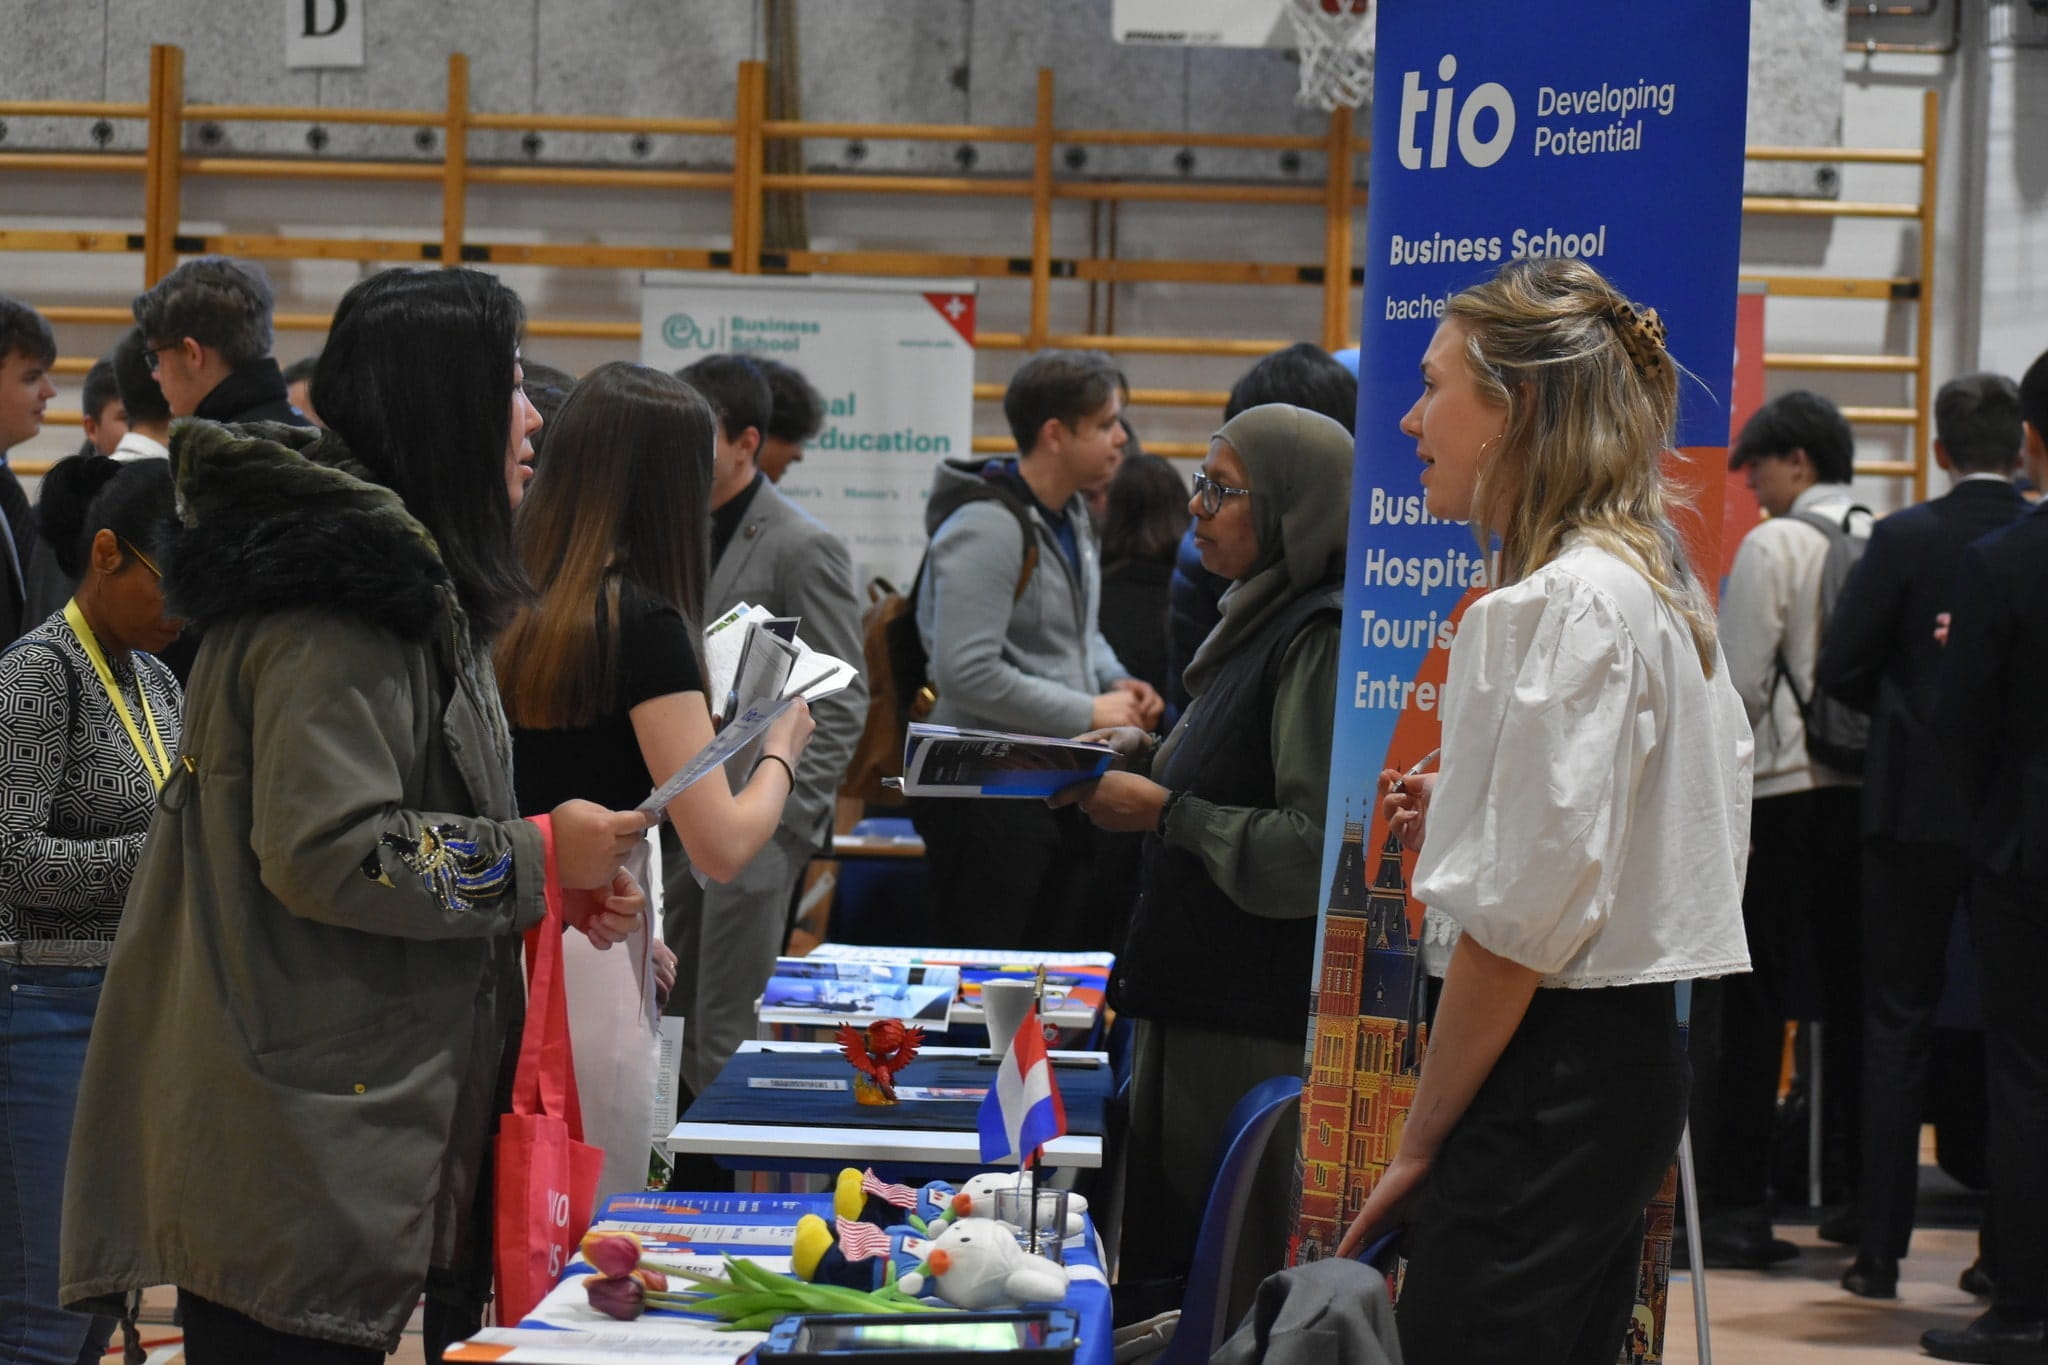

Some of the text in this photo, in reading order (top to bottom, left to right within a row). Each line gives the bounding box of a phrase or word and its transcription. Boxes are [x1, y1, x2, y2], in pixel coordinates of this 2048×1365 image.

[301, 0, 348, 38] D
[1398, 54, 1516, 170] tio
[1537, 78, 1676, 118] Developing
[1534, 120, 1642, 157] Potential
[1390, 224, 1606, 266] Business School
[731, 316, 821, 334] Business
[1364, 548, 1500, 596] Hospital
[1361, 610, 1456, 650] Touris
